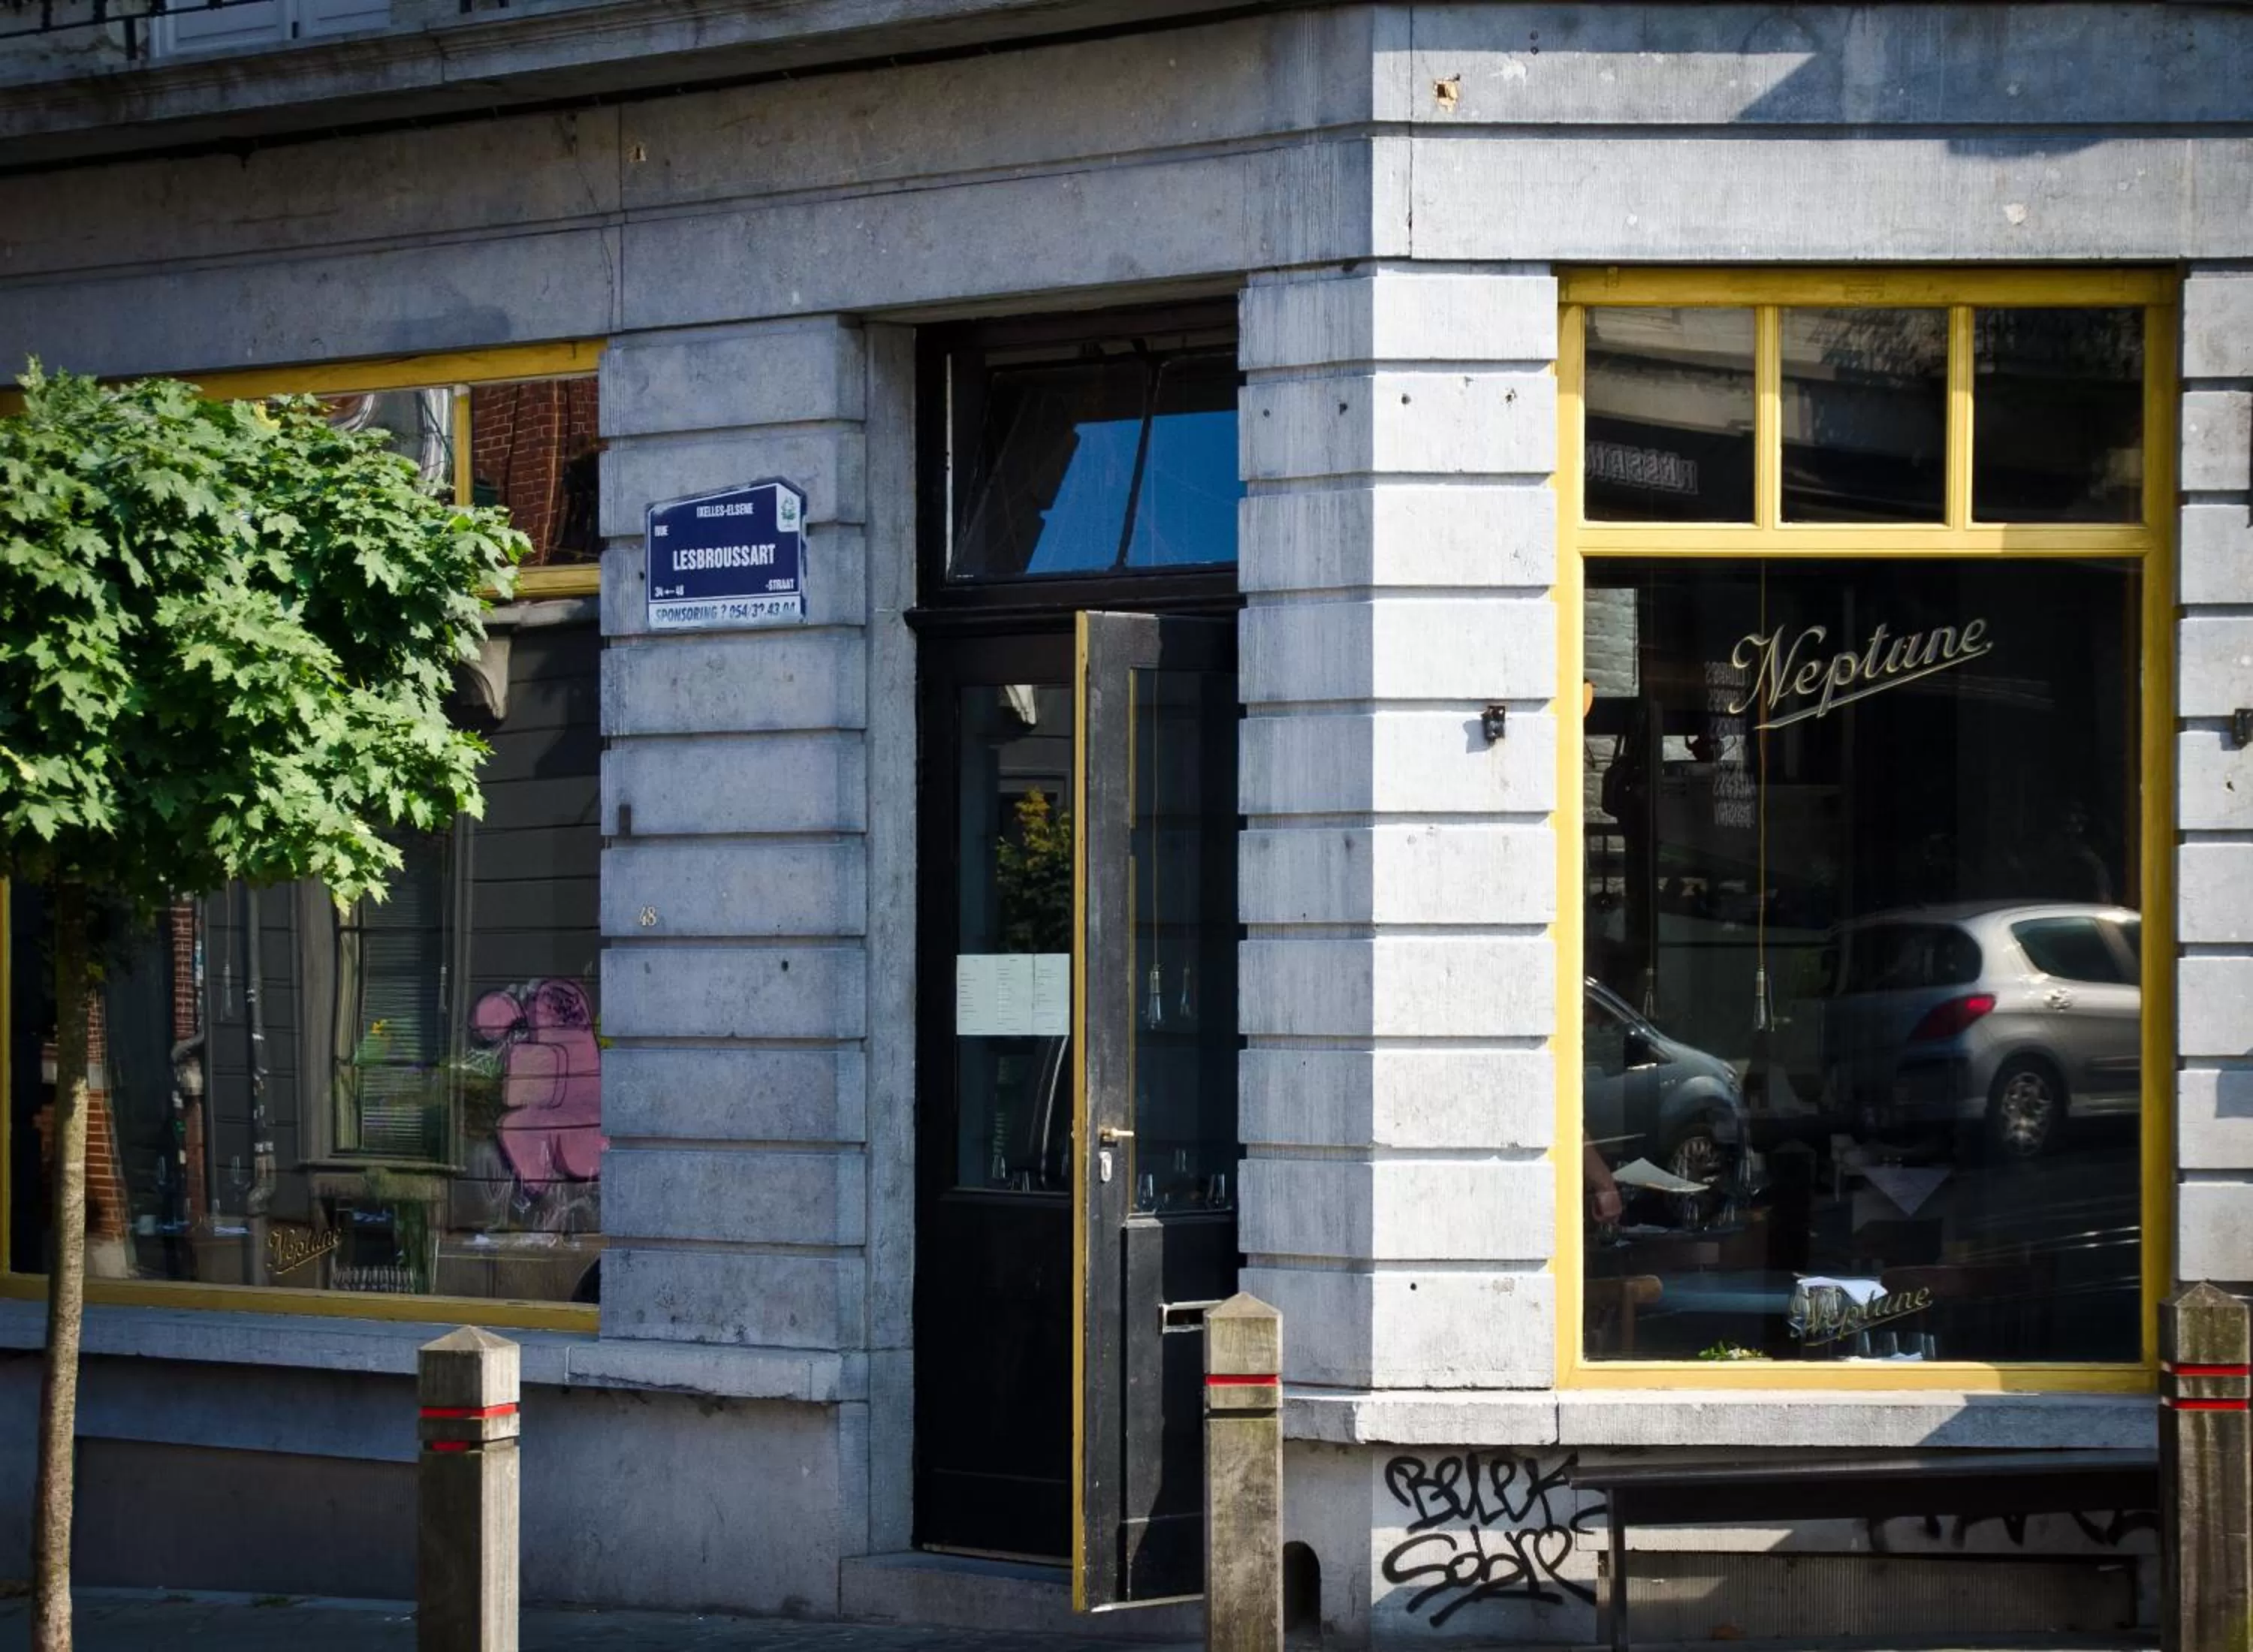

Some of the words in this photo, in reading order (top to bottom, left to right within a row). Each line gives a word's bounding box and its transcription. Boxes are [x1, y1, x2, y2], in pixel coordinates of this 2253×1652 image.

[696, 502, 754, 518] IXELLES-ELSENE
[654, 525, 668, 537] RUE
[672, 543, 776, 571] LESBROUSSART
[656, 605, 717, 622] SPONSORING
[1729, 617, 1994, 719] Neptune
